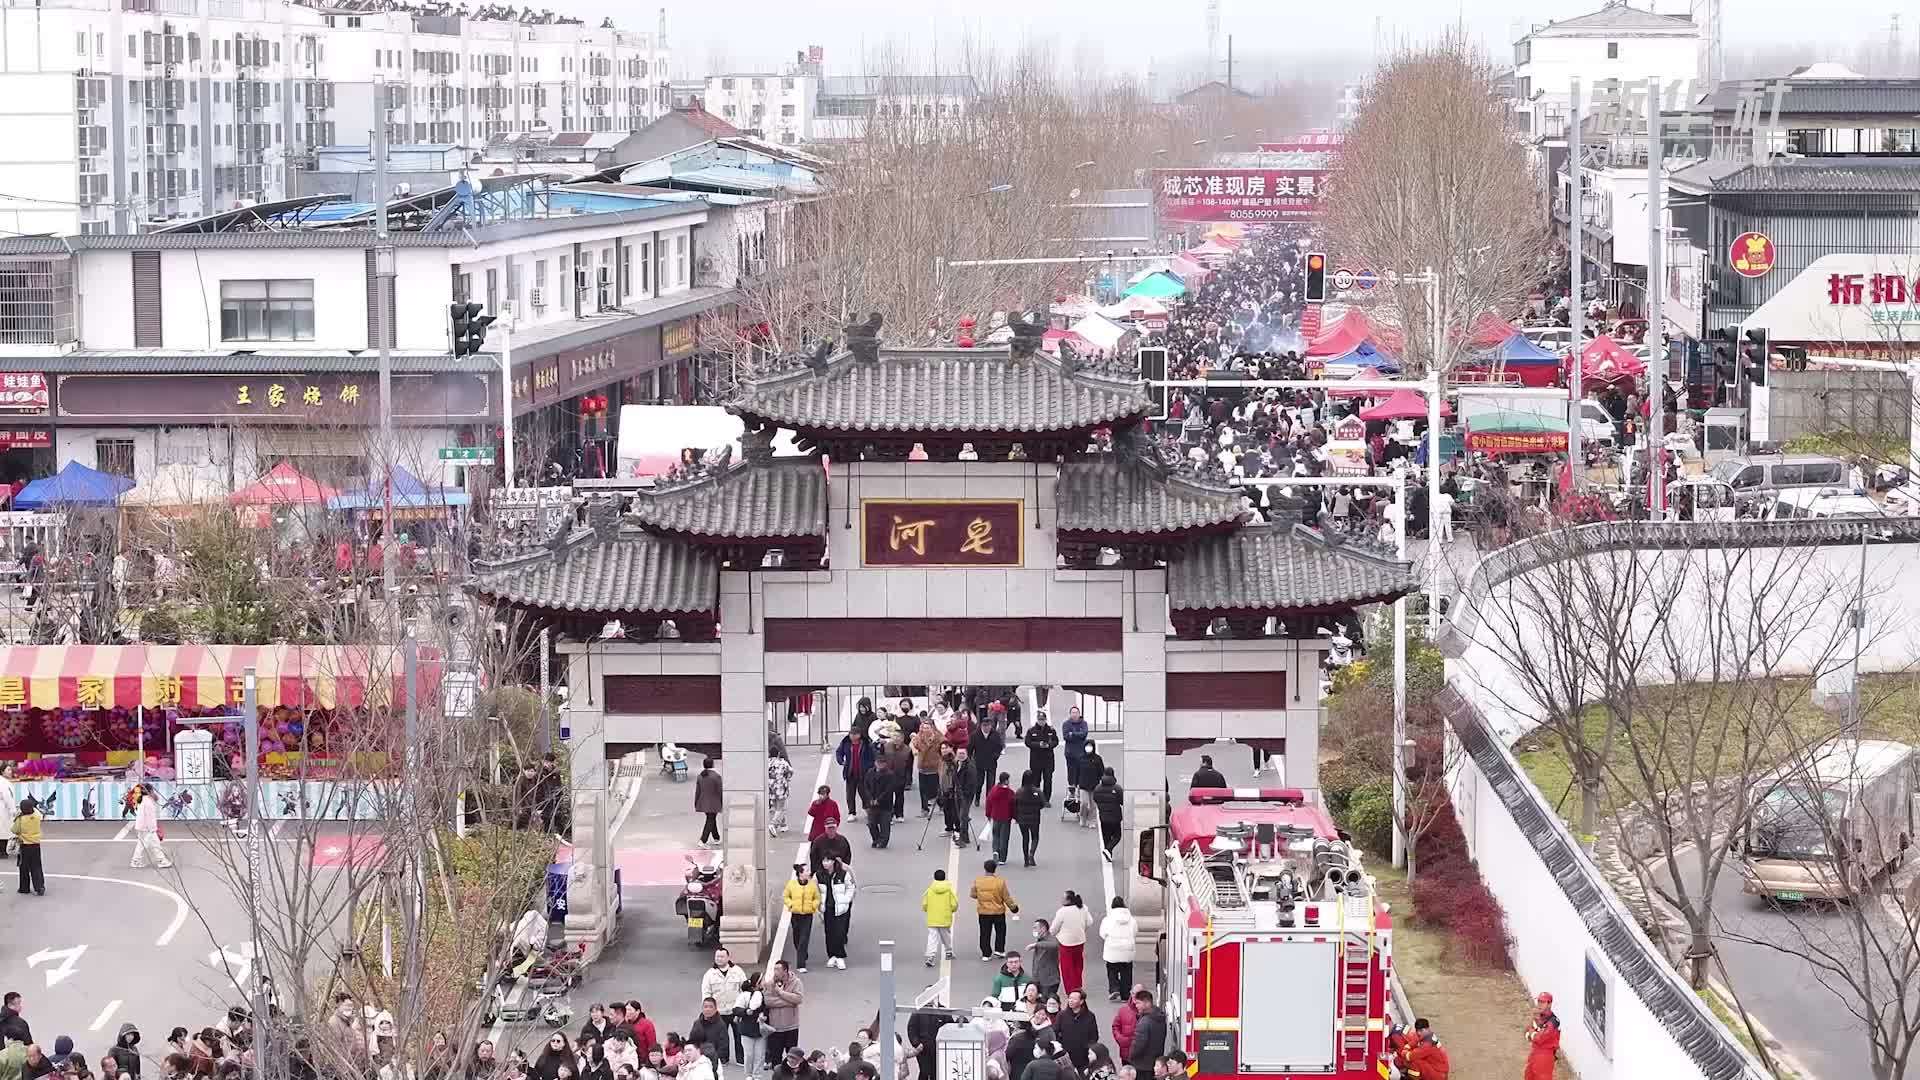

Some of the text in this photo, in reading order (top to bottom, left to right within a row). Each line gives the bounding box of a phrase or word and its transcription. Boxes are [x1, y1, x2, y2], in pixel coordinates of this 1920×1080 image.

[1163, 176, 1329, 196] 城芯准现房 实景
[1230, 210, 1279, 219] 80559999
[1828, 273, 1920, 304] 折扣
[4, 374, 42, 387] 娃娃鱼
[236, 383, 360, 408] 王家烧饼
[890, 515, 995, 556] 皂河
